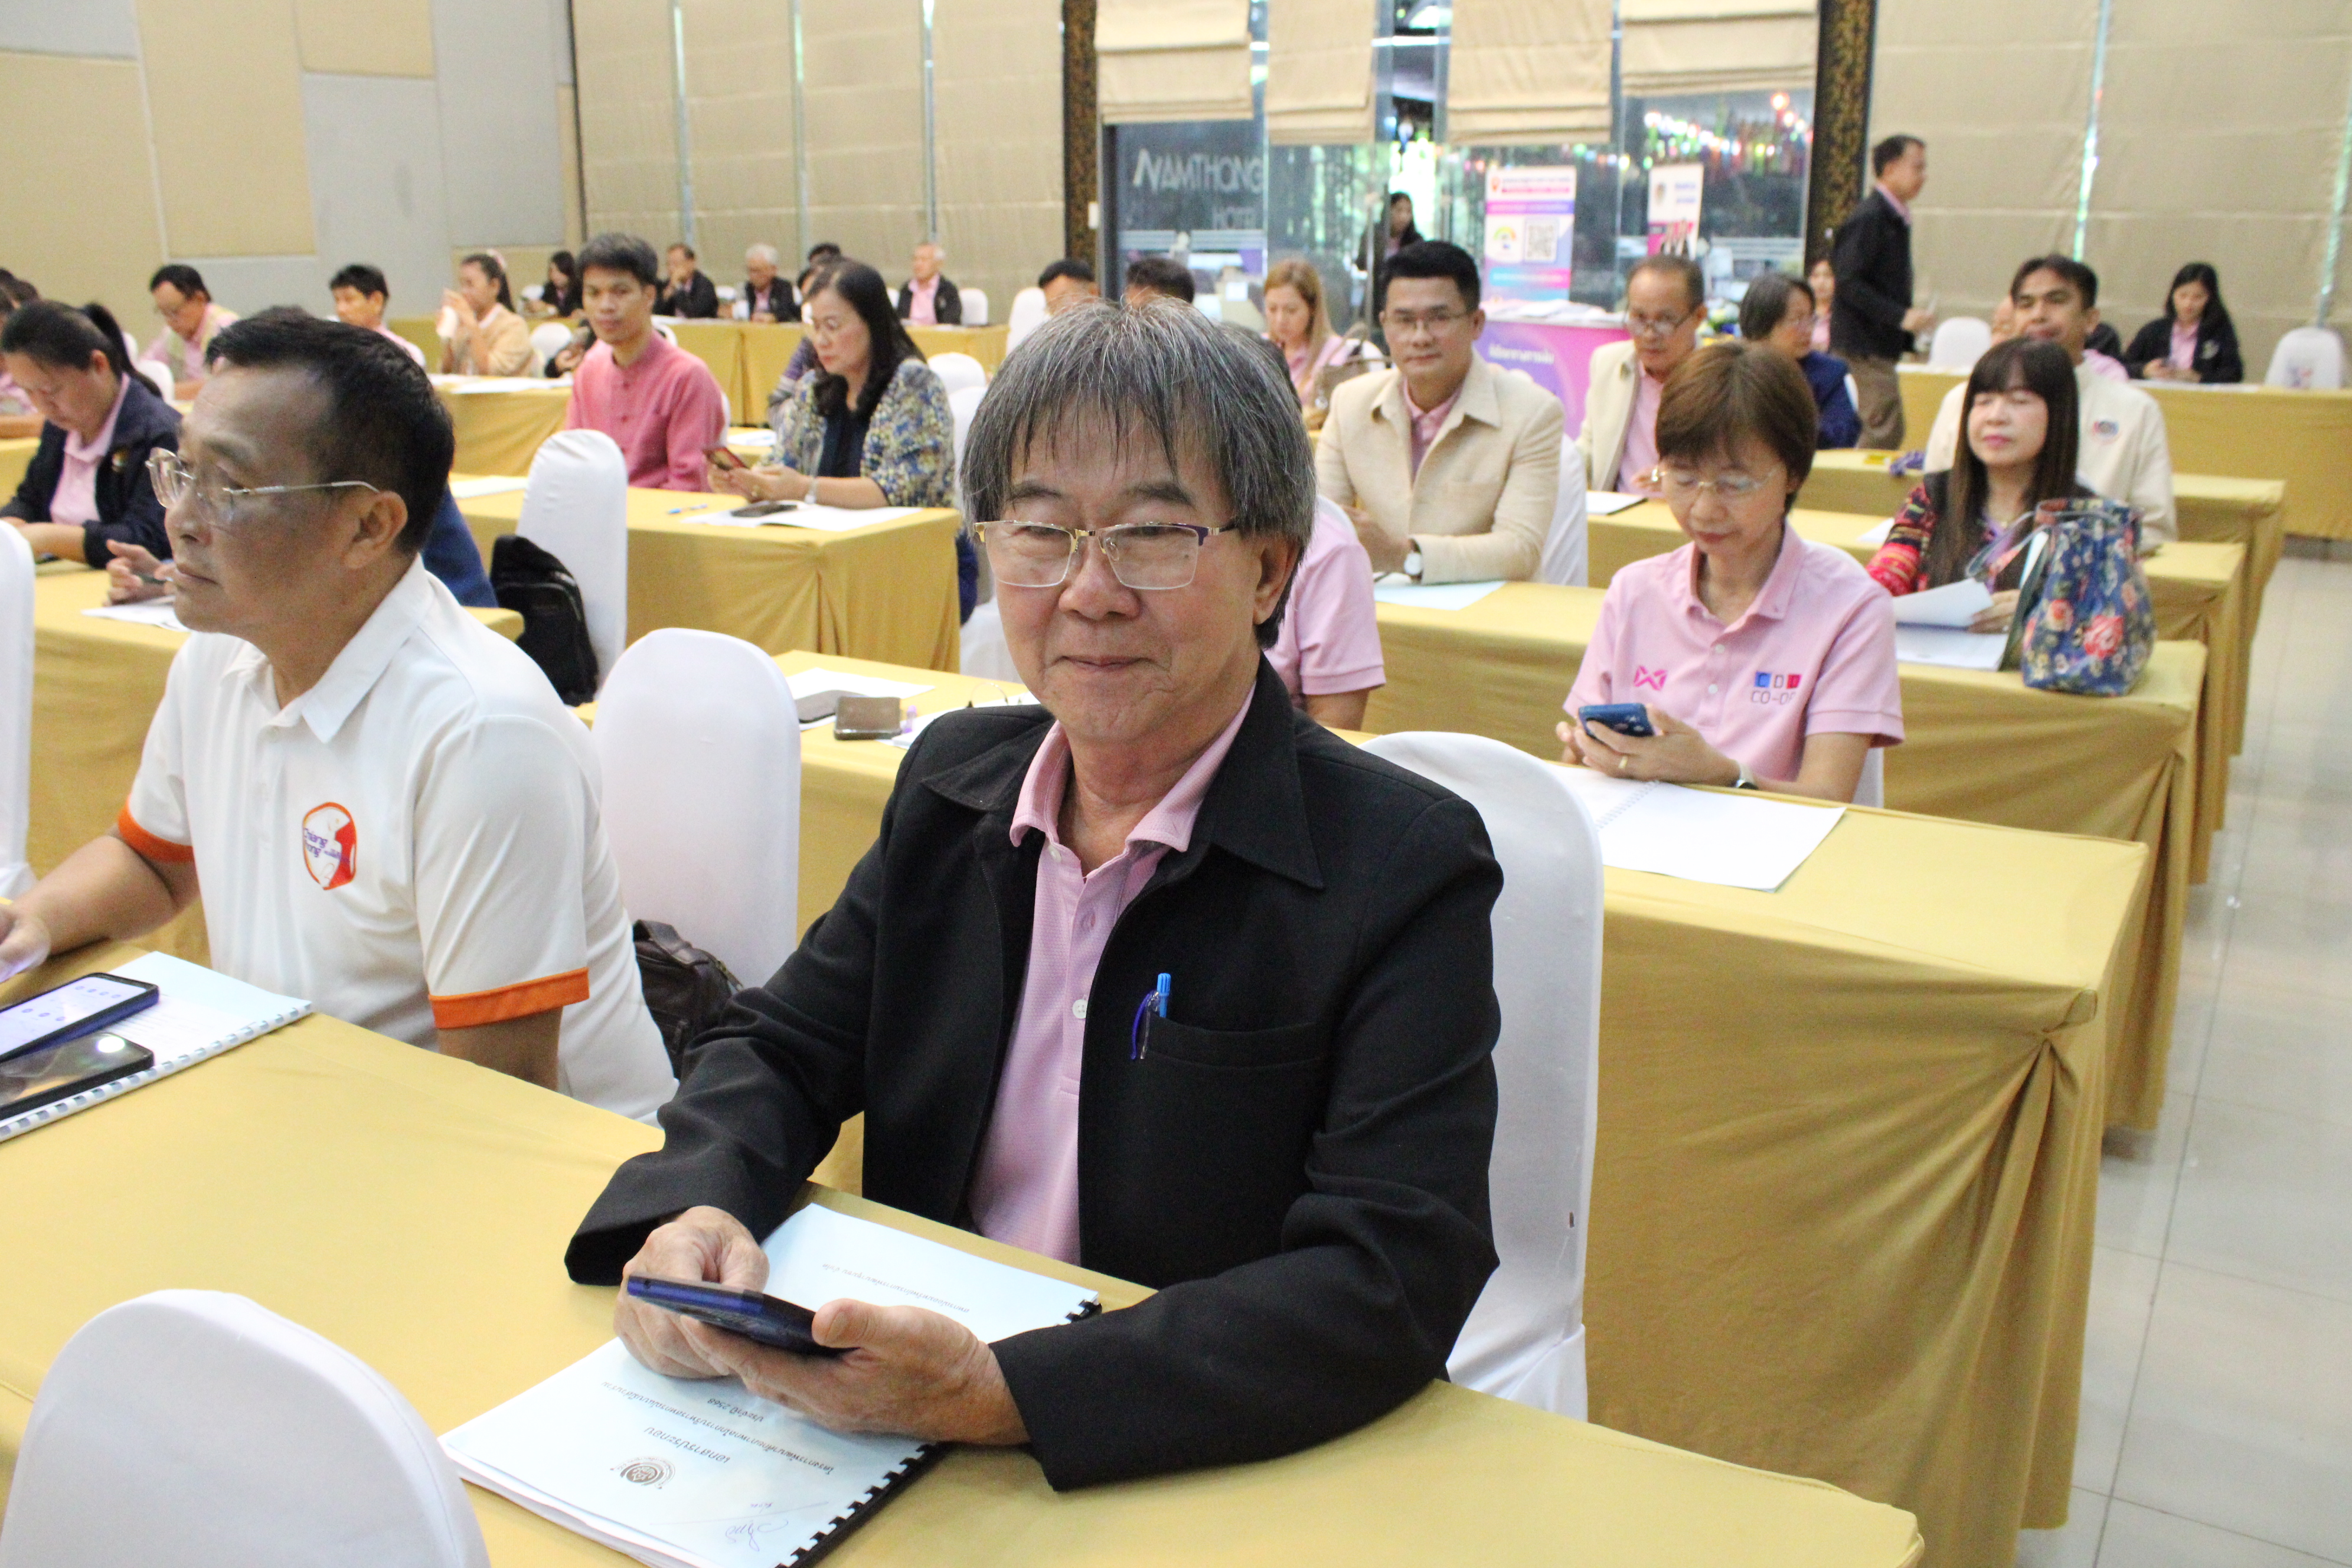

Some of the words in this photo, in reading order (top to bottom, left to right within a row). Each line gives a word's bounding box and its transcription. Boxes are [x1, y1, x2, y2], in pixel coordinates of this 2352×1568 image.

[707, 1397, 729, 1411] 2568
[729, 1406, 764, 1423] ประจำปี
[644, 1427, 730, 1464] เอกสารประกอบ
